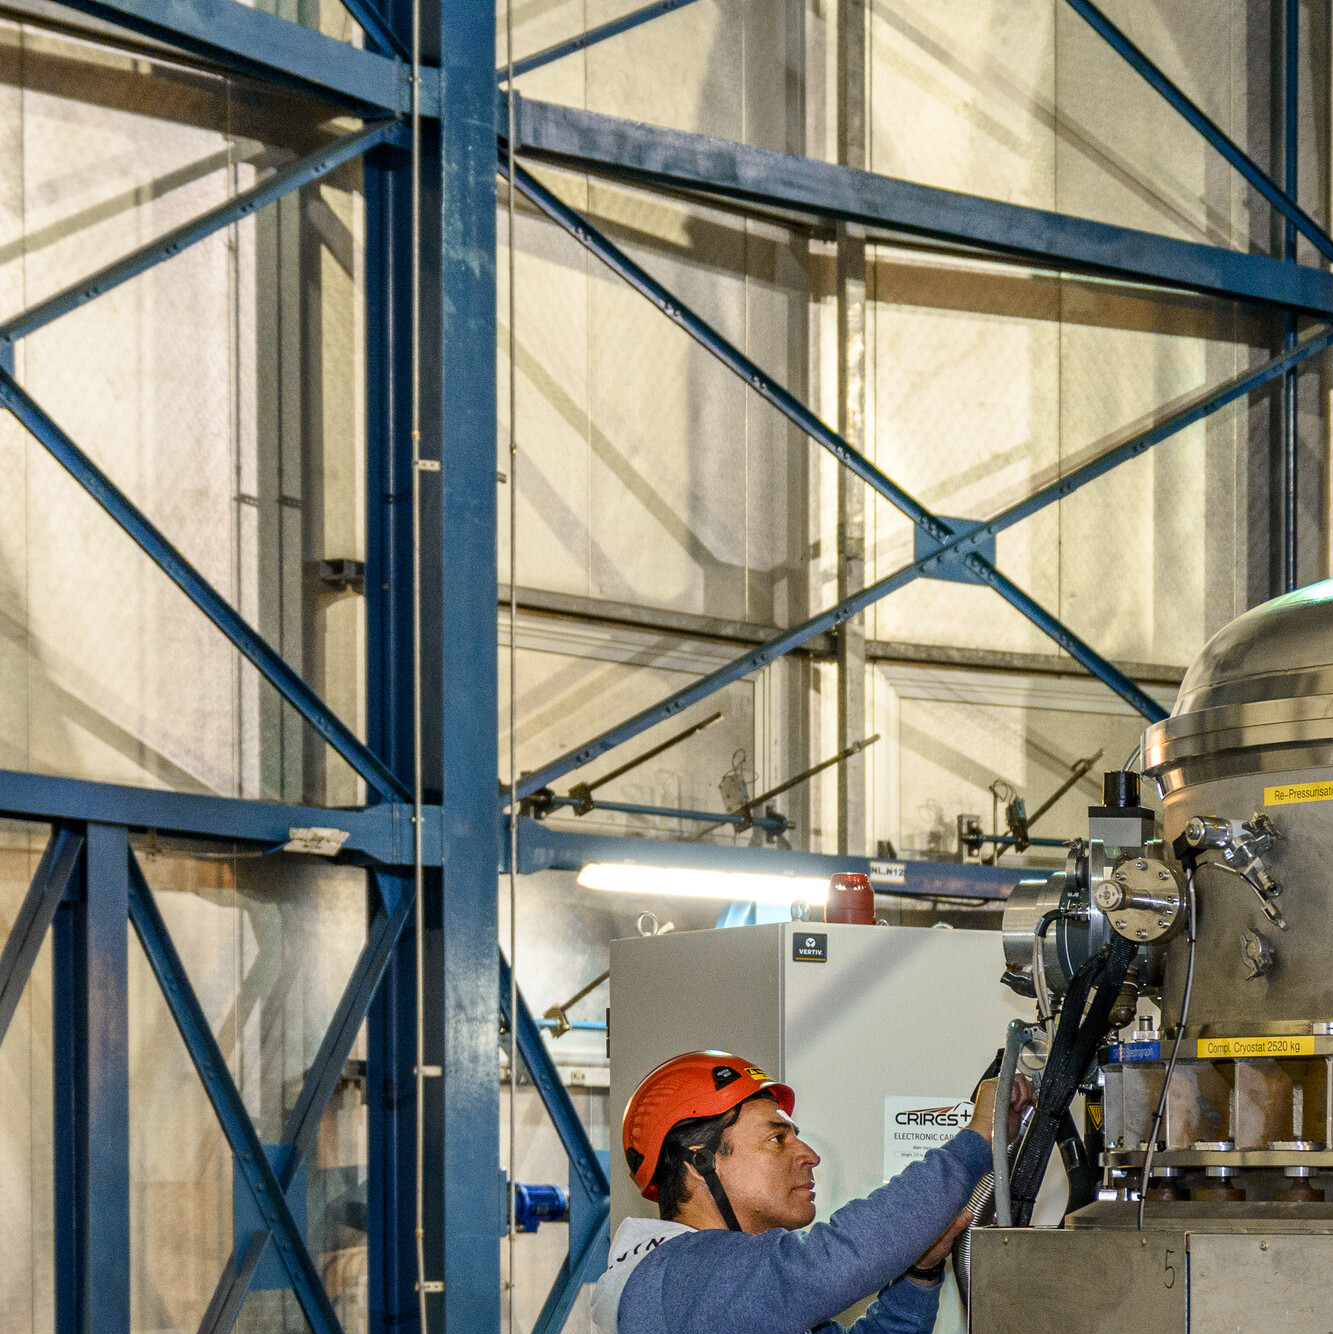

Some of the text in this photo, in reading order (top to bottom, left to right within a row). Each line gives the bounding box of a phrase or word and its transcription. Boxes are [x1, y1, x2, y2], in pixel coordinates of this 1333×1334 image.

[1208, 1040, 1300, 1055] Compl. Cryostat 2520 kg
[894, 1132, 938, 1141] ELECTRONIC
[1164, 1249, 1175, 1289] 5
